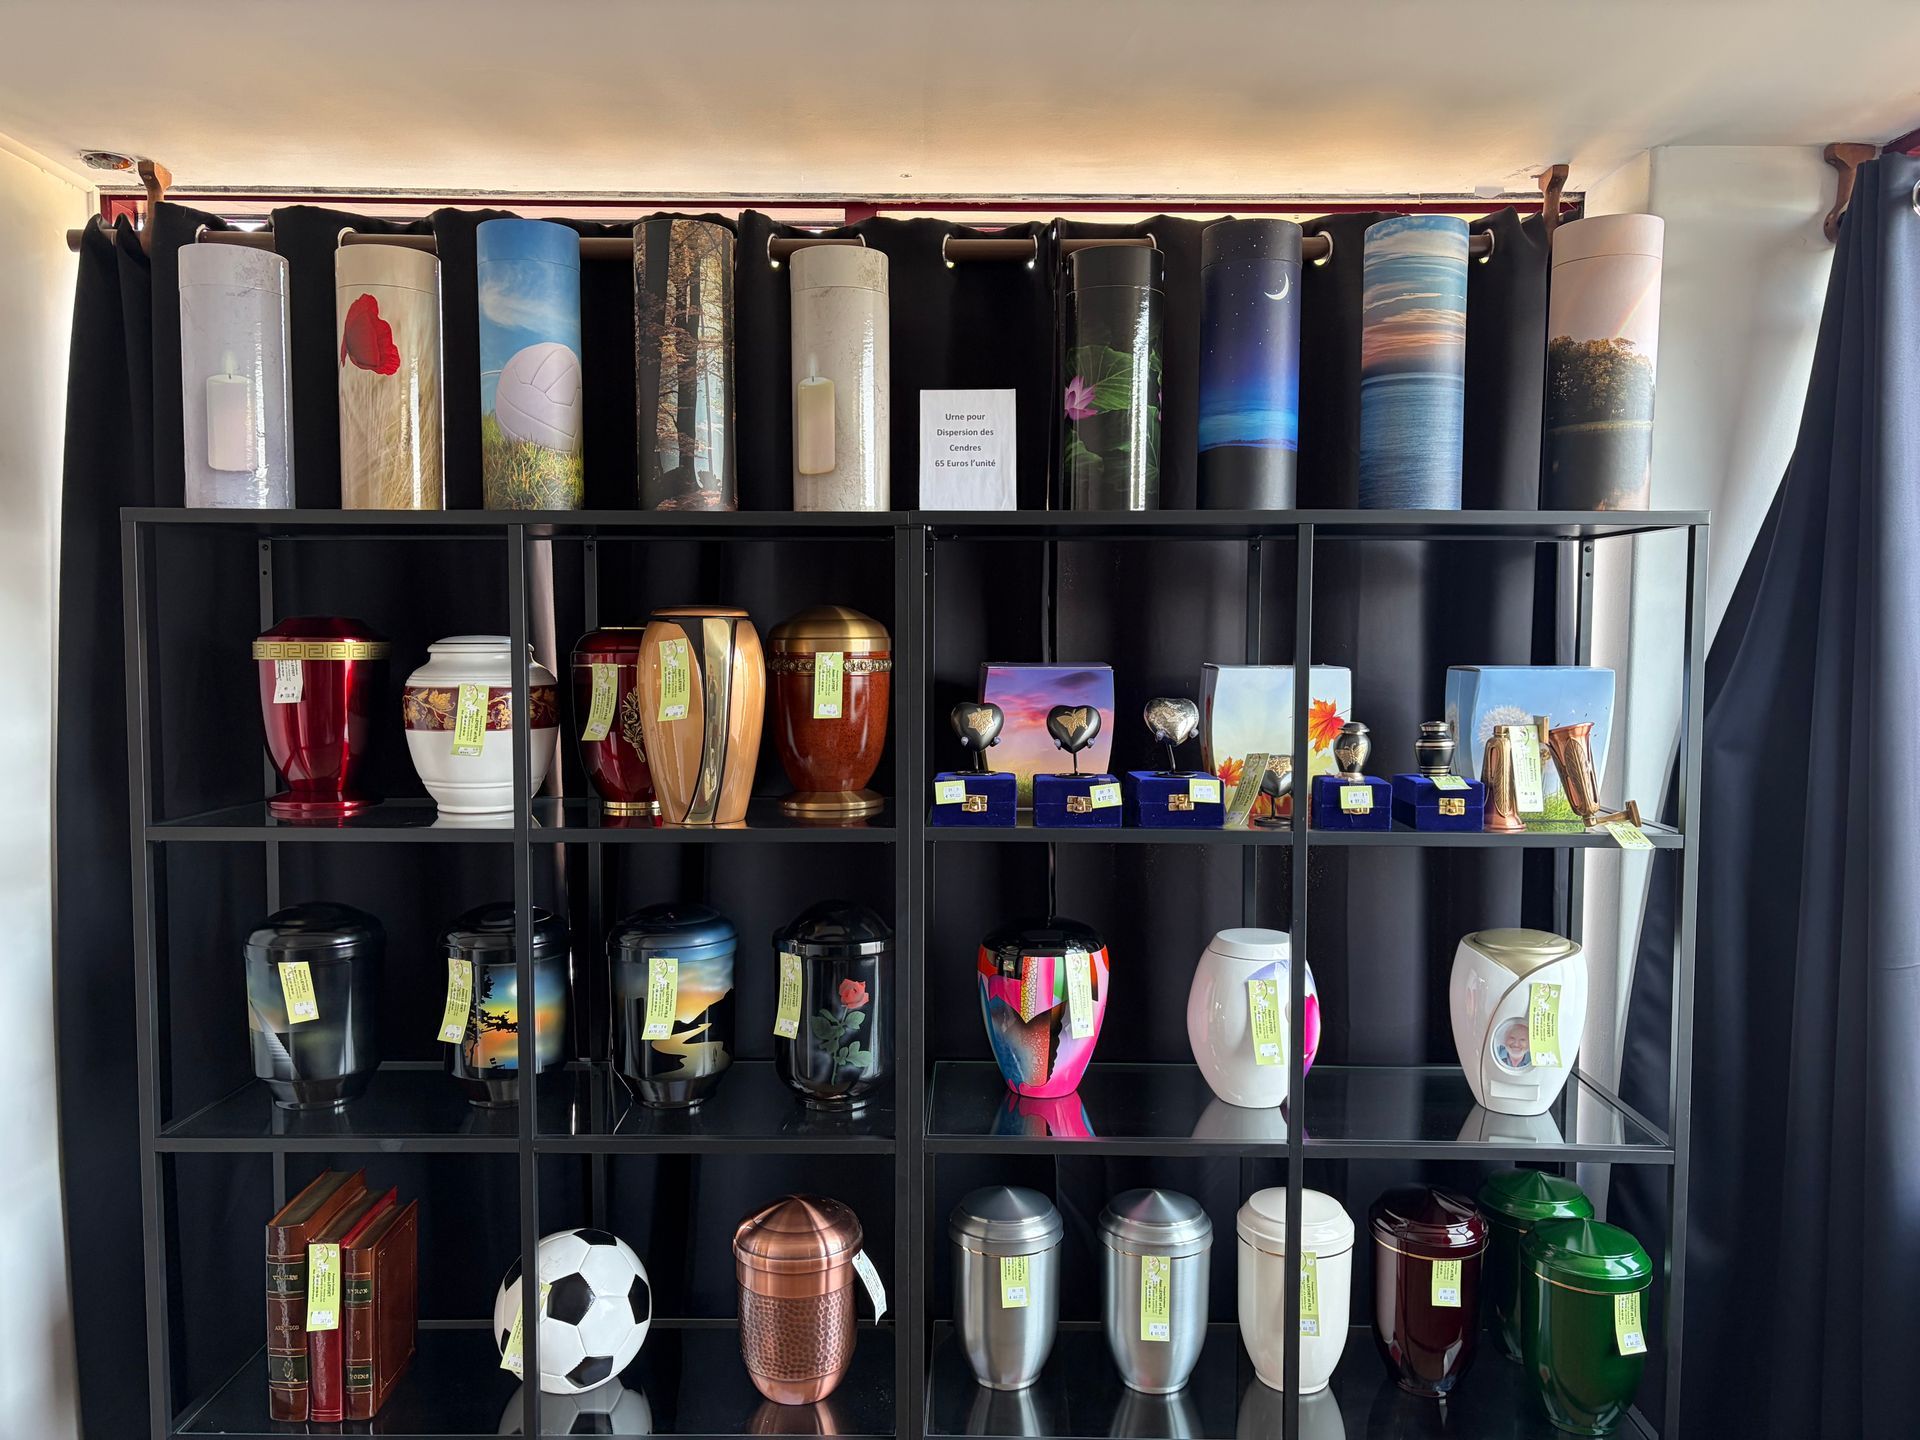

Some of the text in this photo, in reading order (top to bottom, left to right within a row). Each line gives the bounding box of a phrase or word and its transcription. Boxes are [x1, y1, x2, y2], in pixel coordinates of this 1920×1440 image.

[945, 413, 986, 422] Urne pour
[936, 428, 994, 437] Dispersion des
[949, 444, 982, 452] Cendres
[935, 459, 945, 468] 65
[947, 459, 969, 468] Euros
